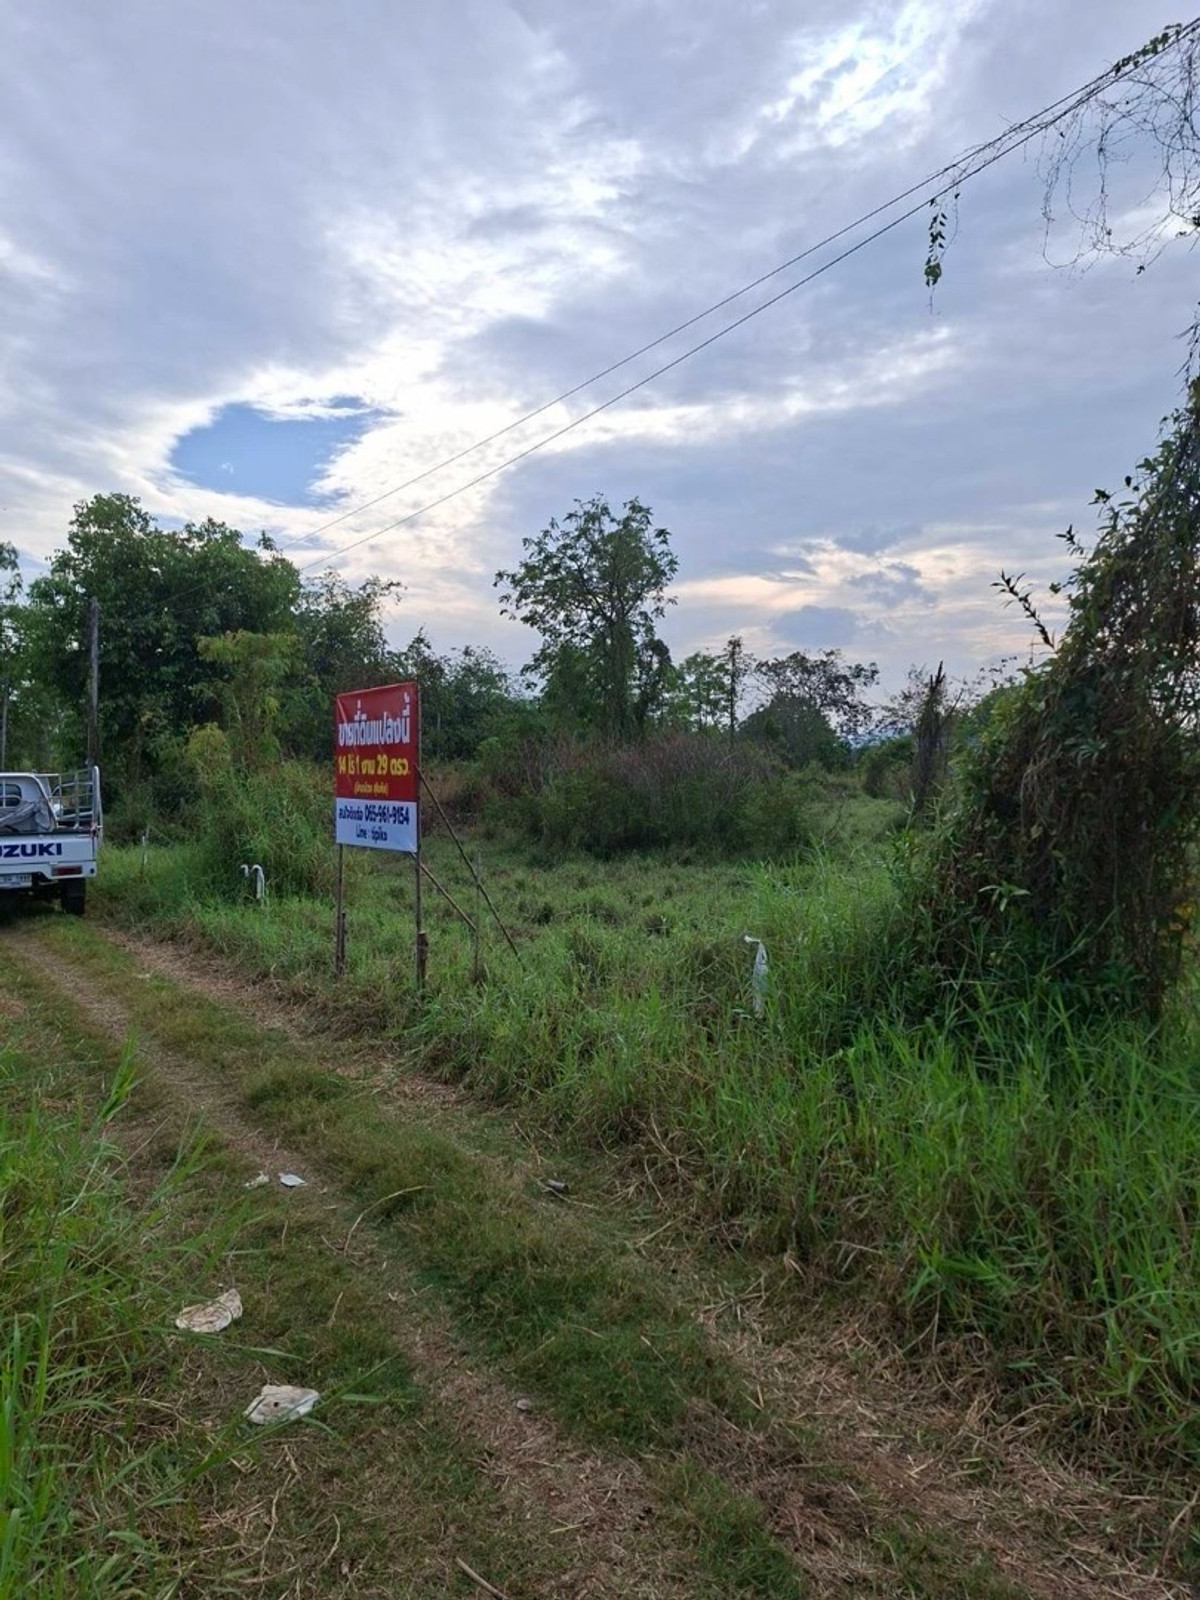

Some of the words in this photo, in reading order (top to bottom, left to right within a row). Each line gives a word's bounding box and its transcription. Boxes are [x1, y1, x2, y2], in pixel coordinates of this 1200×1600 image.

[338, 692, 410, 746] ขายที่ดินแปลงนี้
[361, 758, 376, 775] งาน
[377, 754, 388, 775] 29
[0, 843, 62, 858] ZUKI
